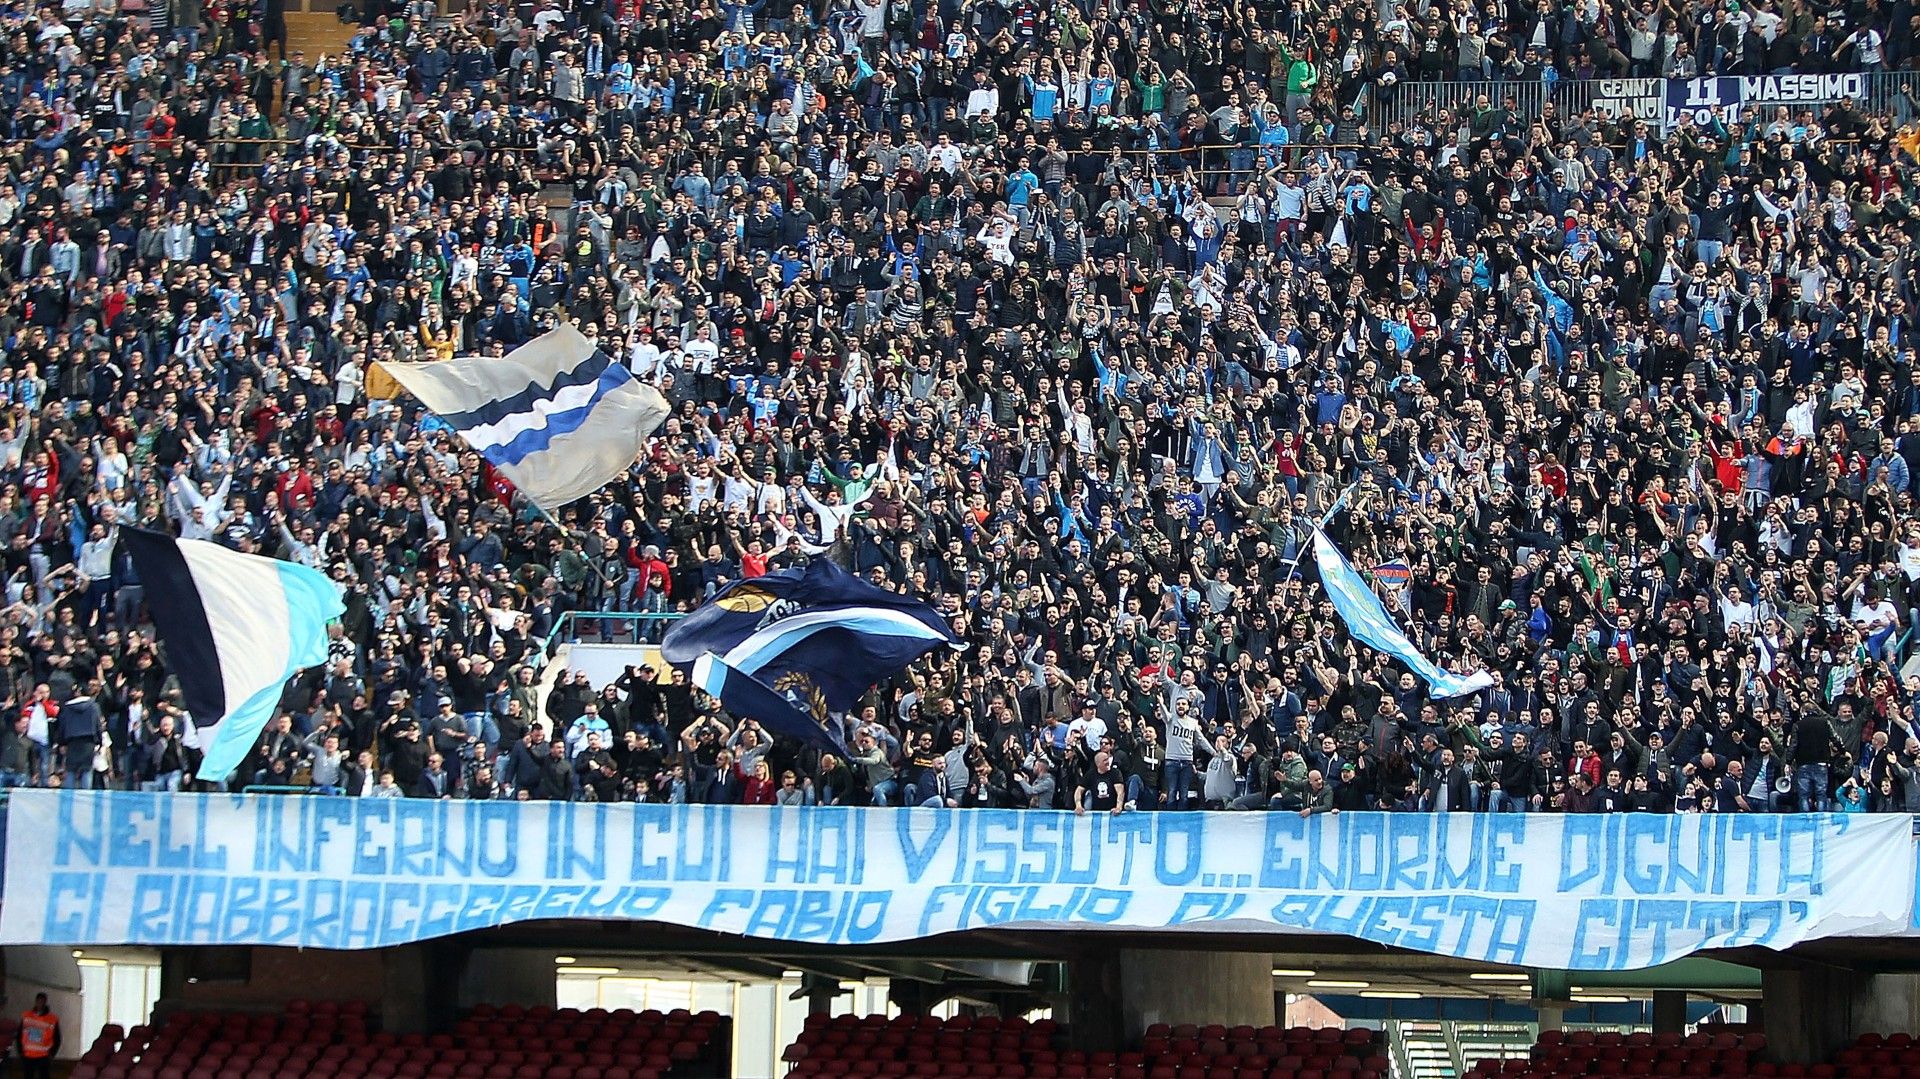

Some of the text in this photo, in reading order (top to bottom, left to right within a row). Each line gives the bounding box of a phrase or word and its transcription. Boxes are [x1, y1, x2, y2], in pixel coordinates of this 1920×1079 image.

[1600, 78, 1657, 98] GENNY
[1686, 77, 1721, 106] 11
[1743, 74, 1862, 101] MASSIMO
[546, 802, 608, 882] IN
[630, 803, 732, 883] CUI
[763, 805, 867, 885] HAI
[1258, 811, 1527, 894] ENORME
[43, 871, 107, 944] CI
[697, 888, 894, 944] FABIO
[917, 883, 1134, 937] FIGLIO
[1270, 894, 1538, 966] QUESTA
